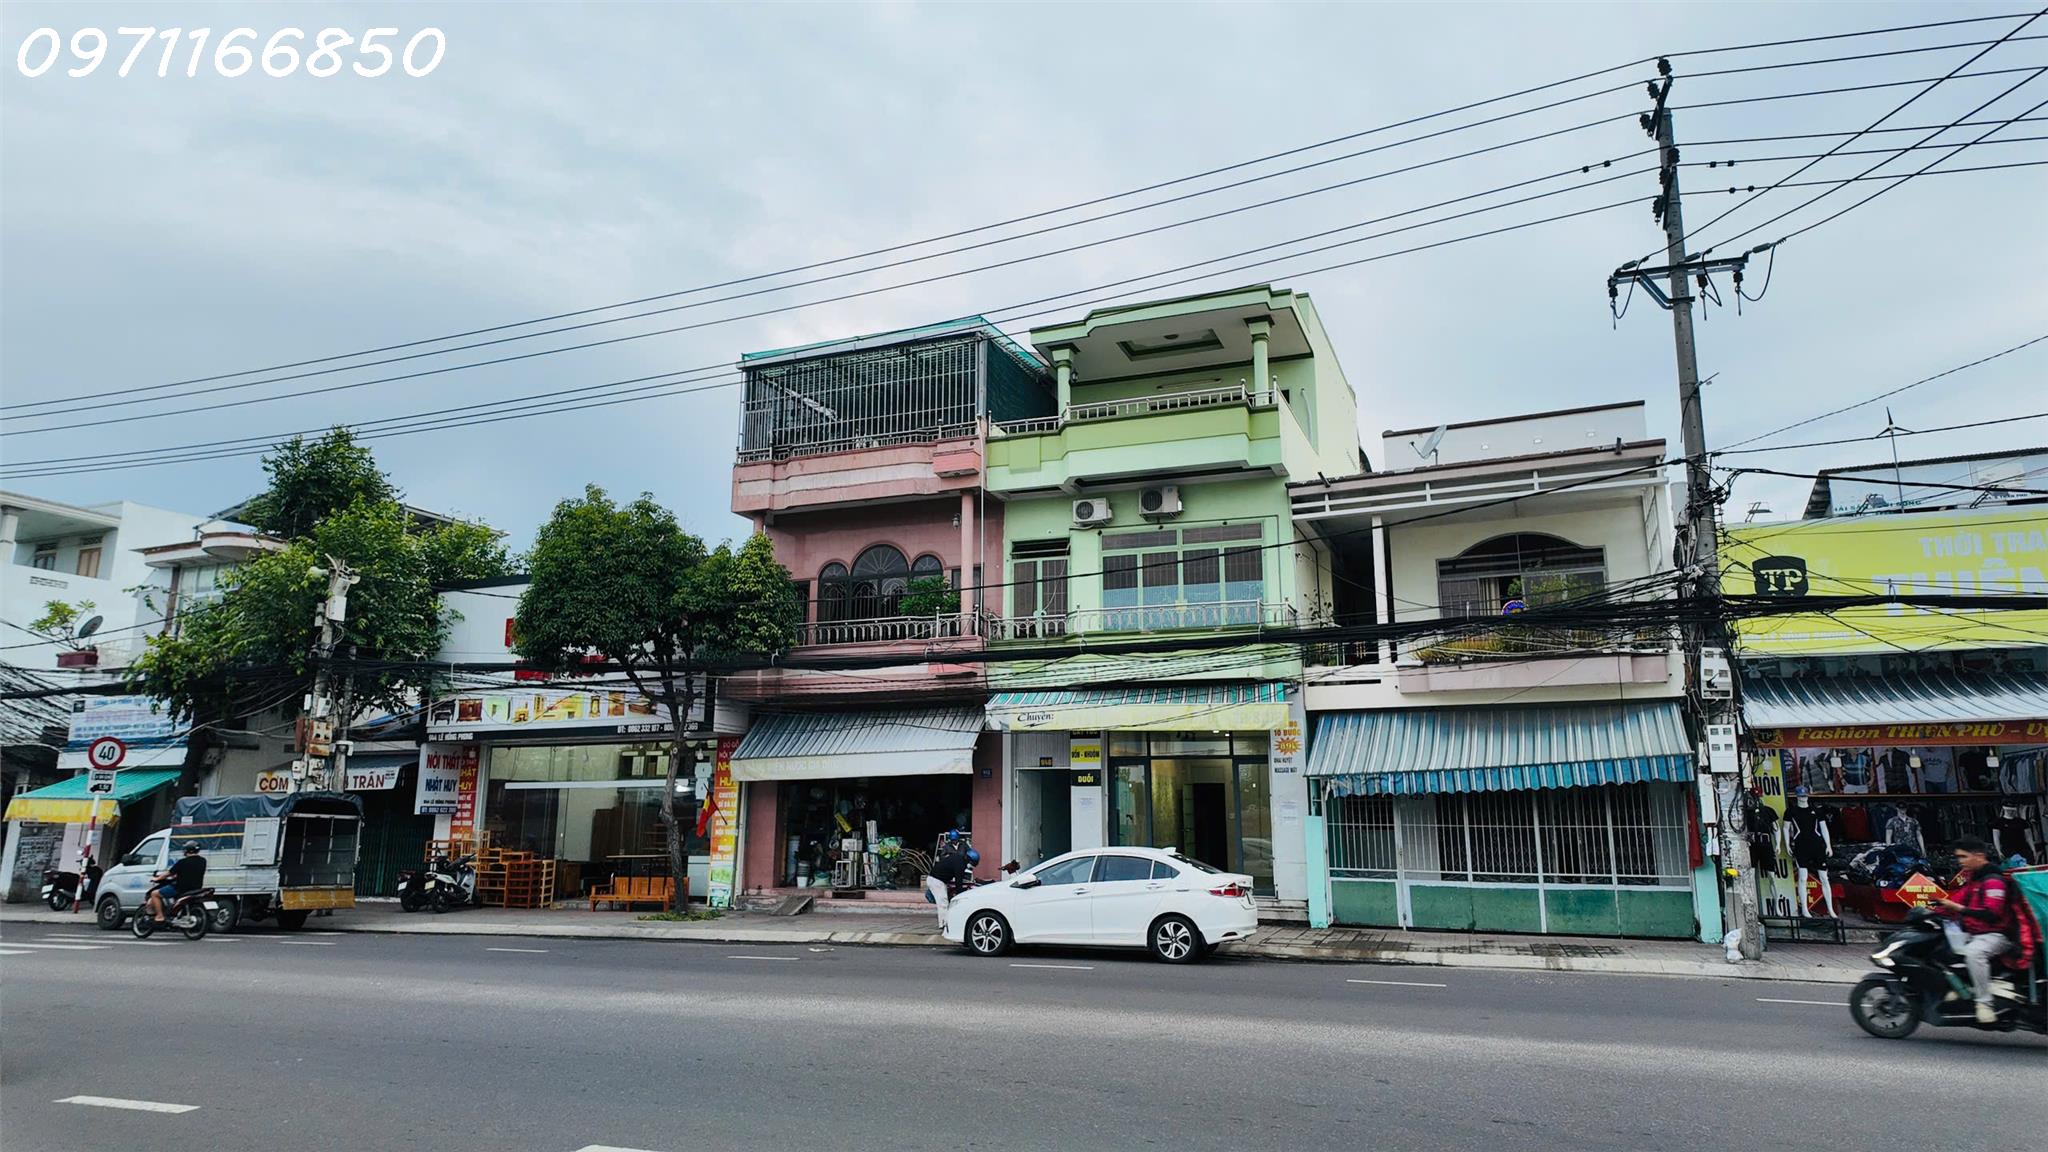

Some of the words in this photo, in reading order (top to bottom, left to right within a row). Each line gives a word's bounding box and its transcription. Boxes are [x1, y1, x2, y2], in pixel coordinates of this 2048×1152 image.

[1920, 530, 1984, 559] THỜI
[1990, 529, 2048, 554] TRA
[1760, 569, 1803, 591] TP
[1798, 726, 1880, 740] Fashion
[98, 746, 116, 761] 40
[426, 751, 441, 772] NỘI
[443, 779, 458, 792] HUY
